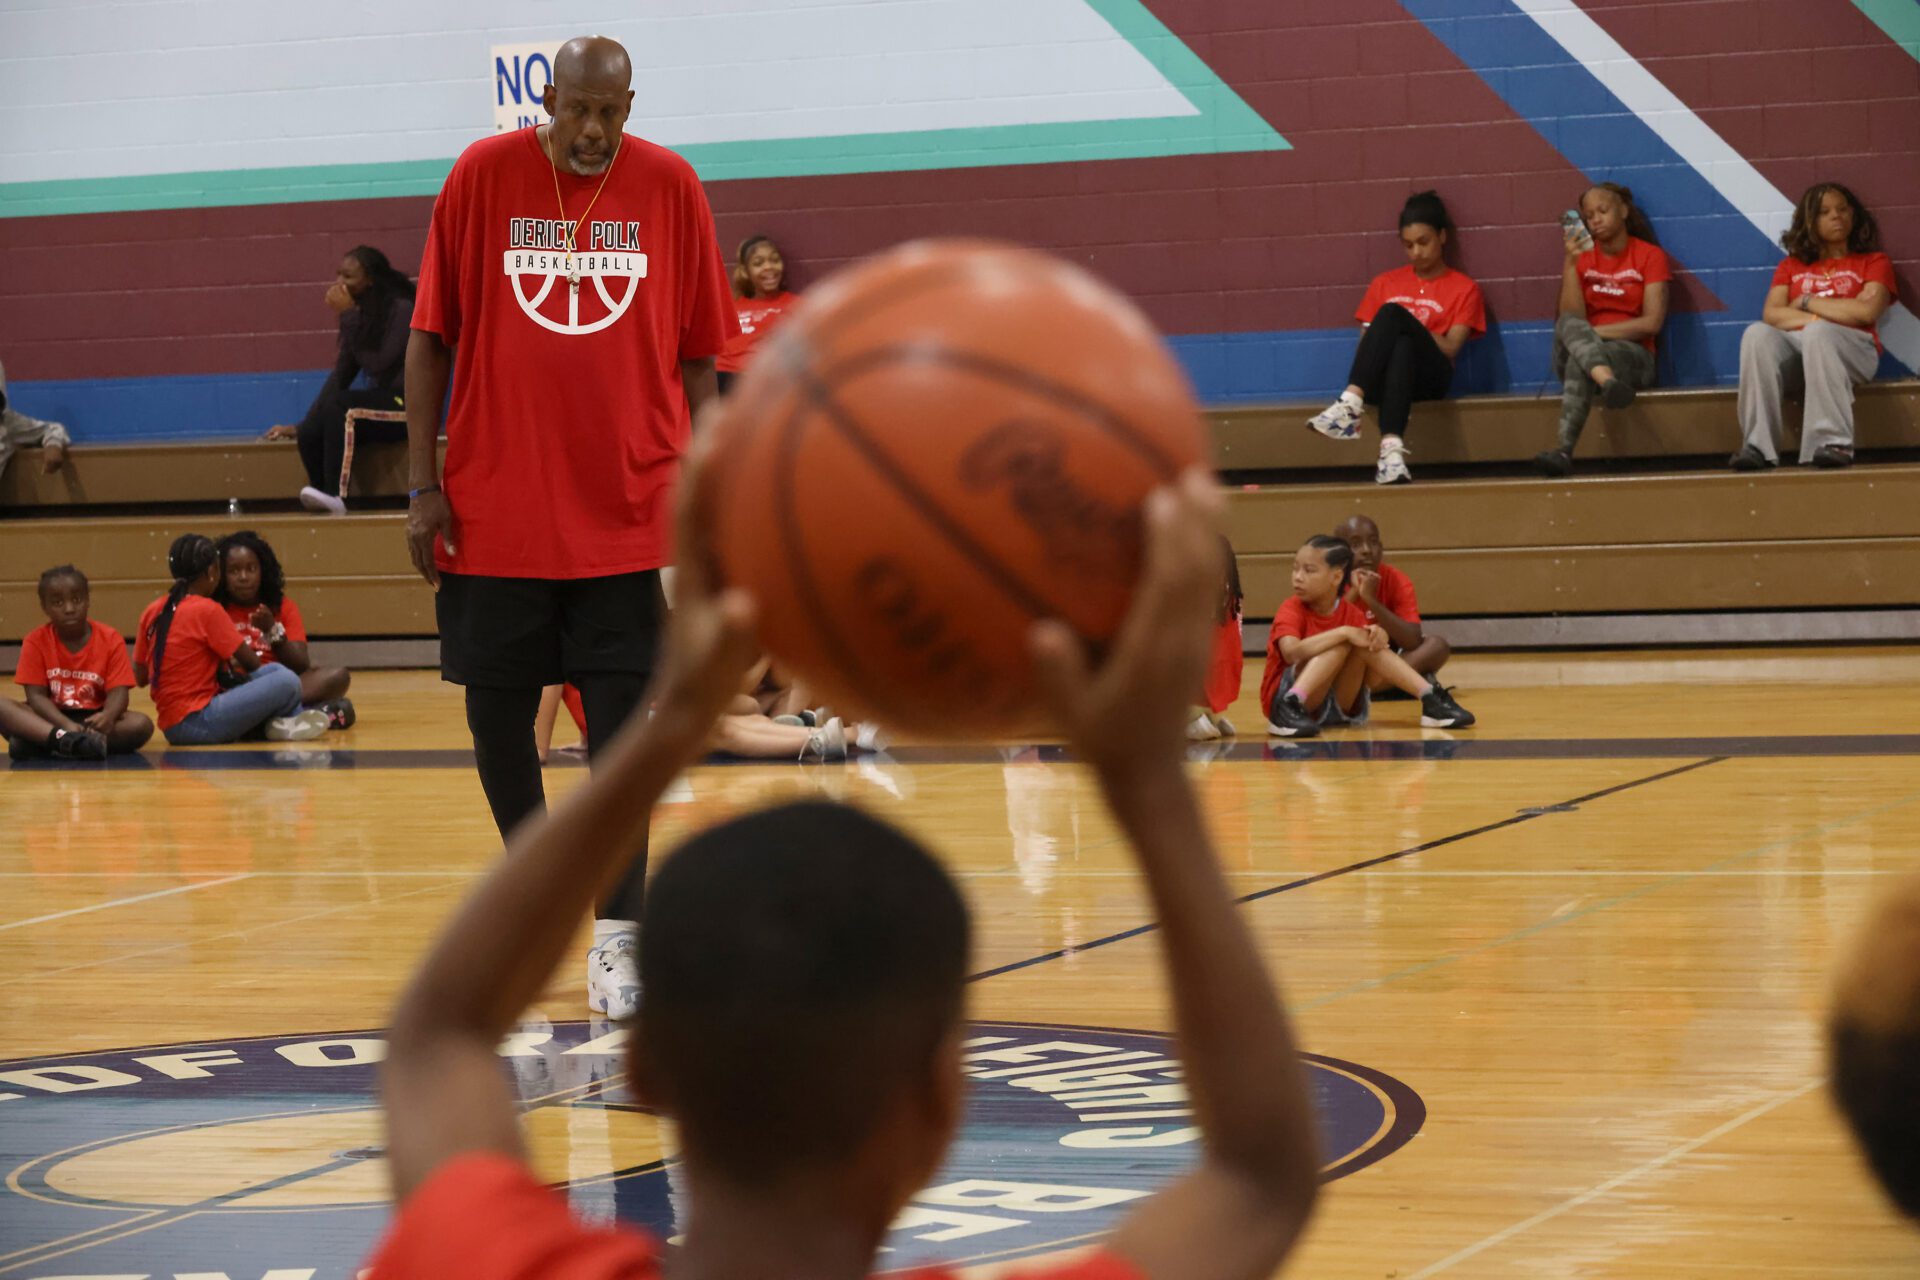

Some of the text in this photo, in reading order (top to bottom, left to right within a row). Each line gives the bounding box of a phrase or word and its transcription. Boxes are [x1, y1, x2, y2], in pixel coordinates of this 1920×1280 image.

[510, 217, 640, 251] DERICK POLK
[515, 254, 633, 271] BASKETBALL
[960, 1036, 1204, 1149] EIGHTS
